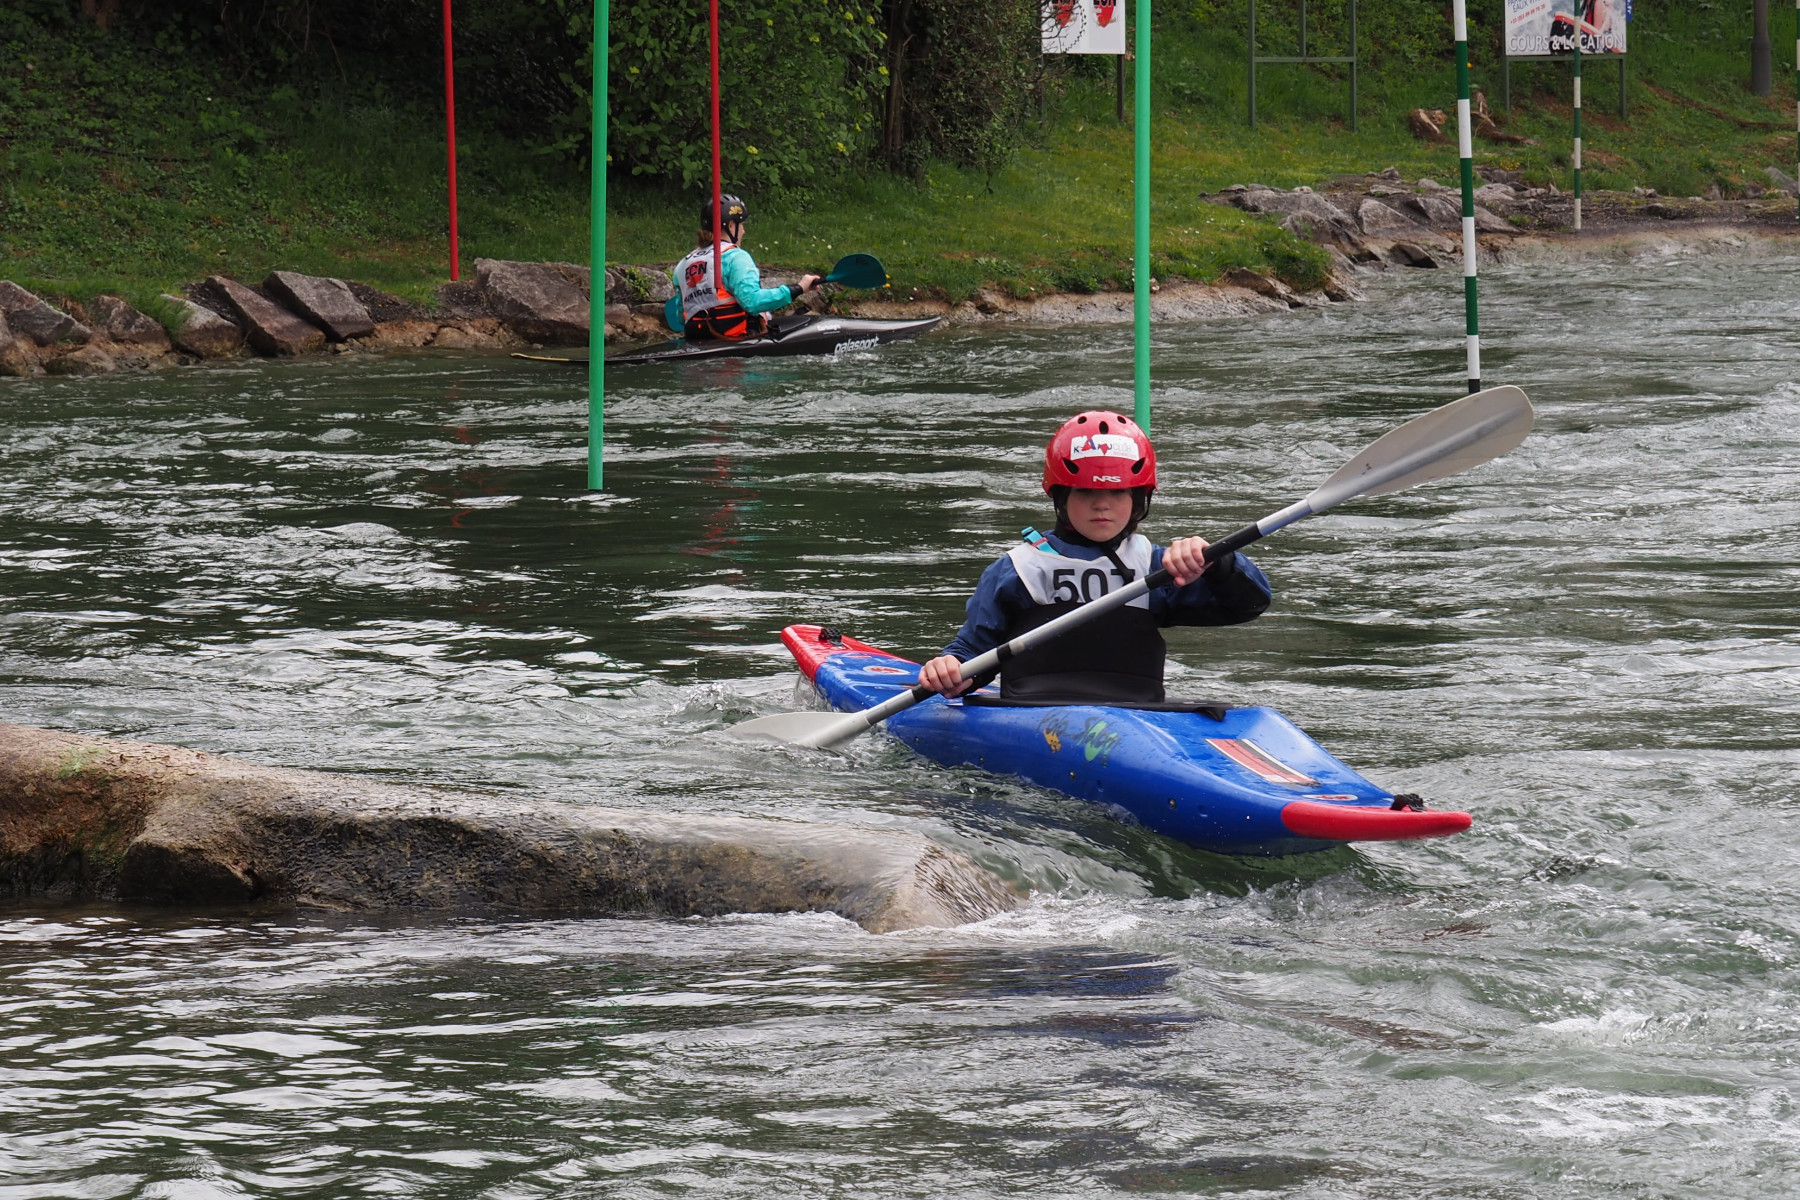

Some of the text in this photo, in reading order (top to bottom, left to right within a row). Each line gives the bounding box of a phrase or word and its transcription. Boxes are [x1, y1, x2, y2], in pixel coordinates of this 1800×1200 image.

[1509, 35, 1549, 51] COURS
[1552, 34, 1560, 50] &
[685, 262, 707, 281] ECN
[1092, 475, 1121, 483] NRS
